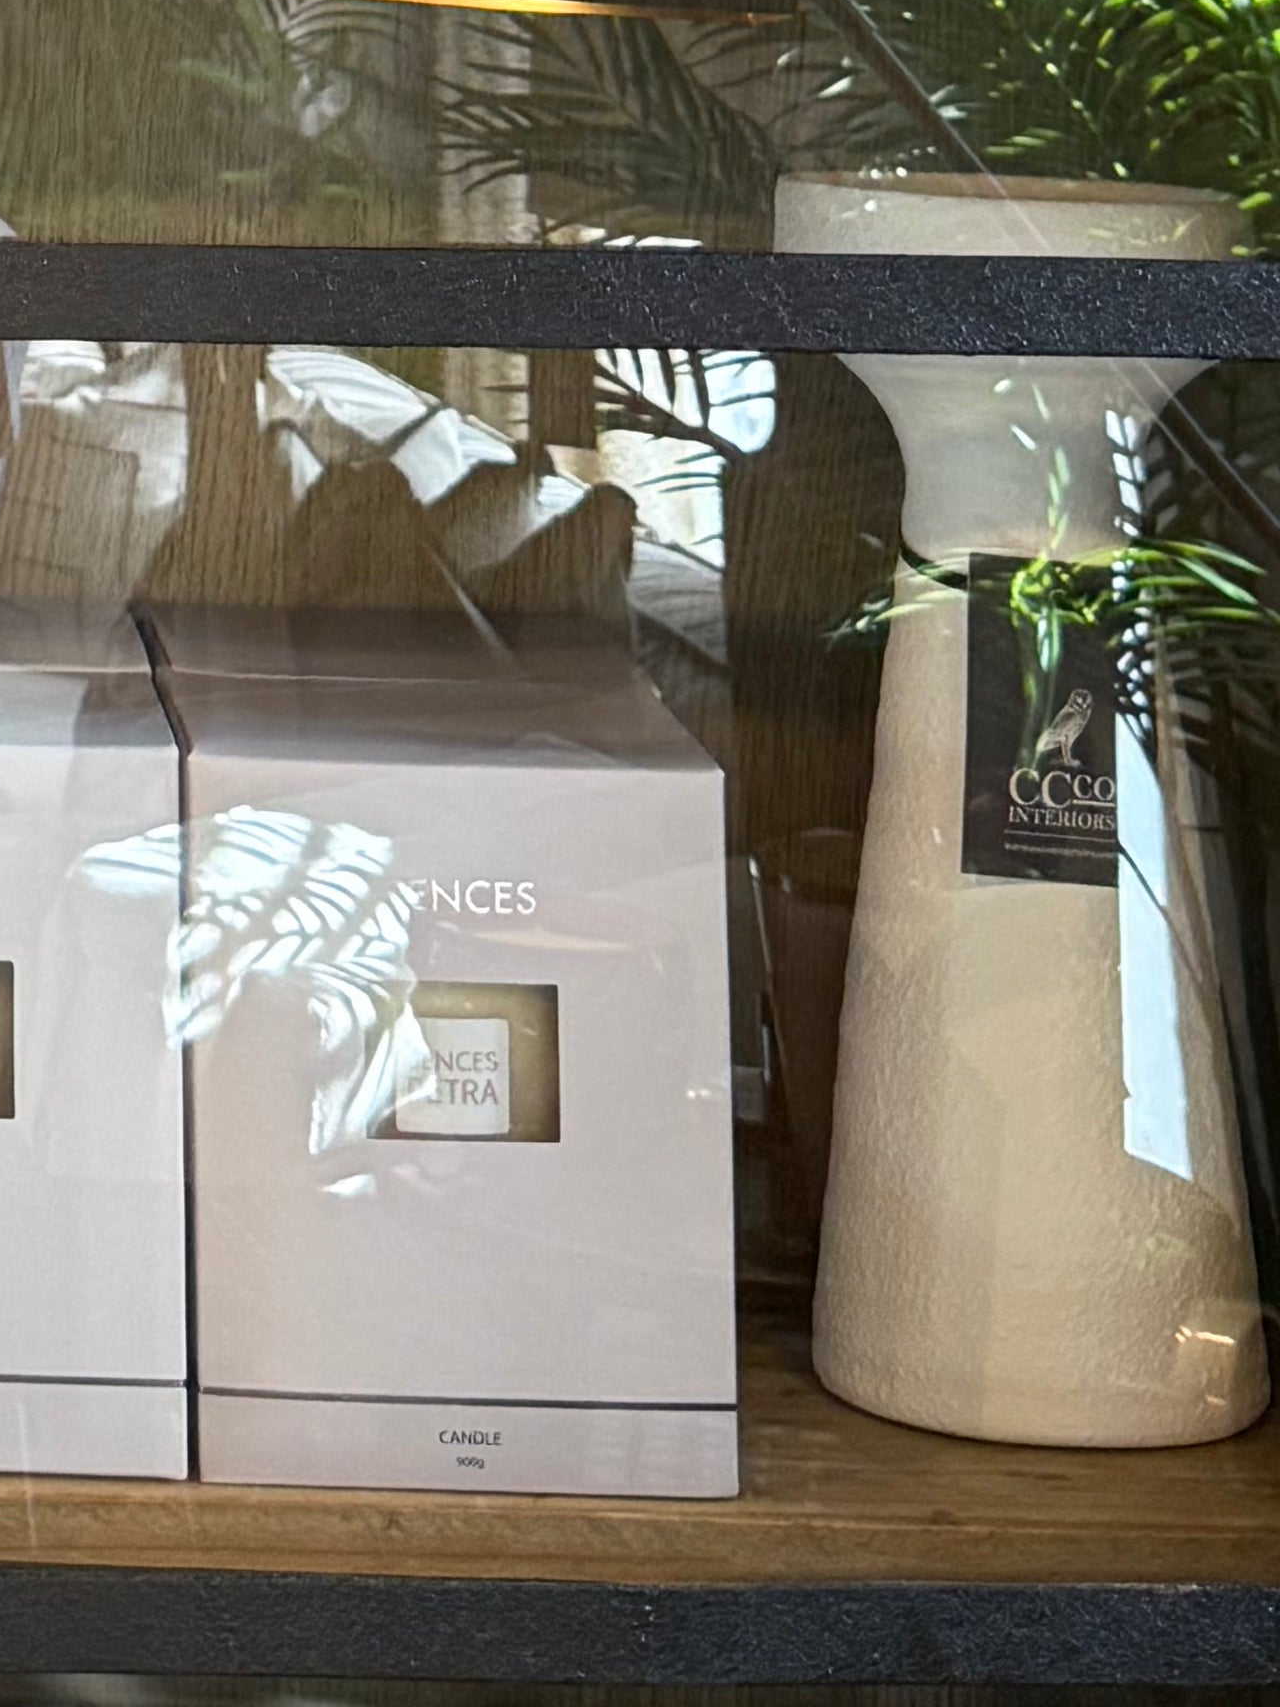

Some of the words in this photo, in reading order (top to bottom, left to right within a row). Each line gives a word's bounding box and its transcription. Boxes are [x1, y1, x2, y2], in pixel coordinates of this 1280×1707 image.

[1008, 804, 1116, 831] INTERIORS
[408, 877, 538, 915] ENCES
[438, 1429, 503, 1447] CANDLE
